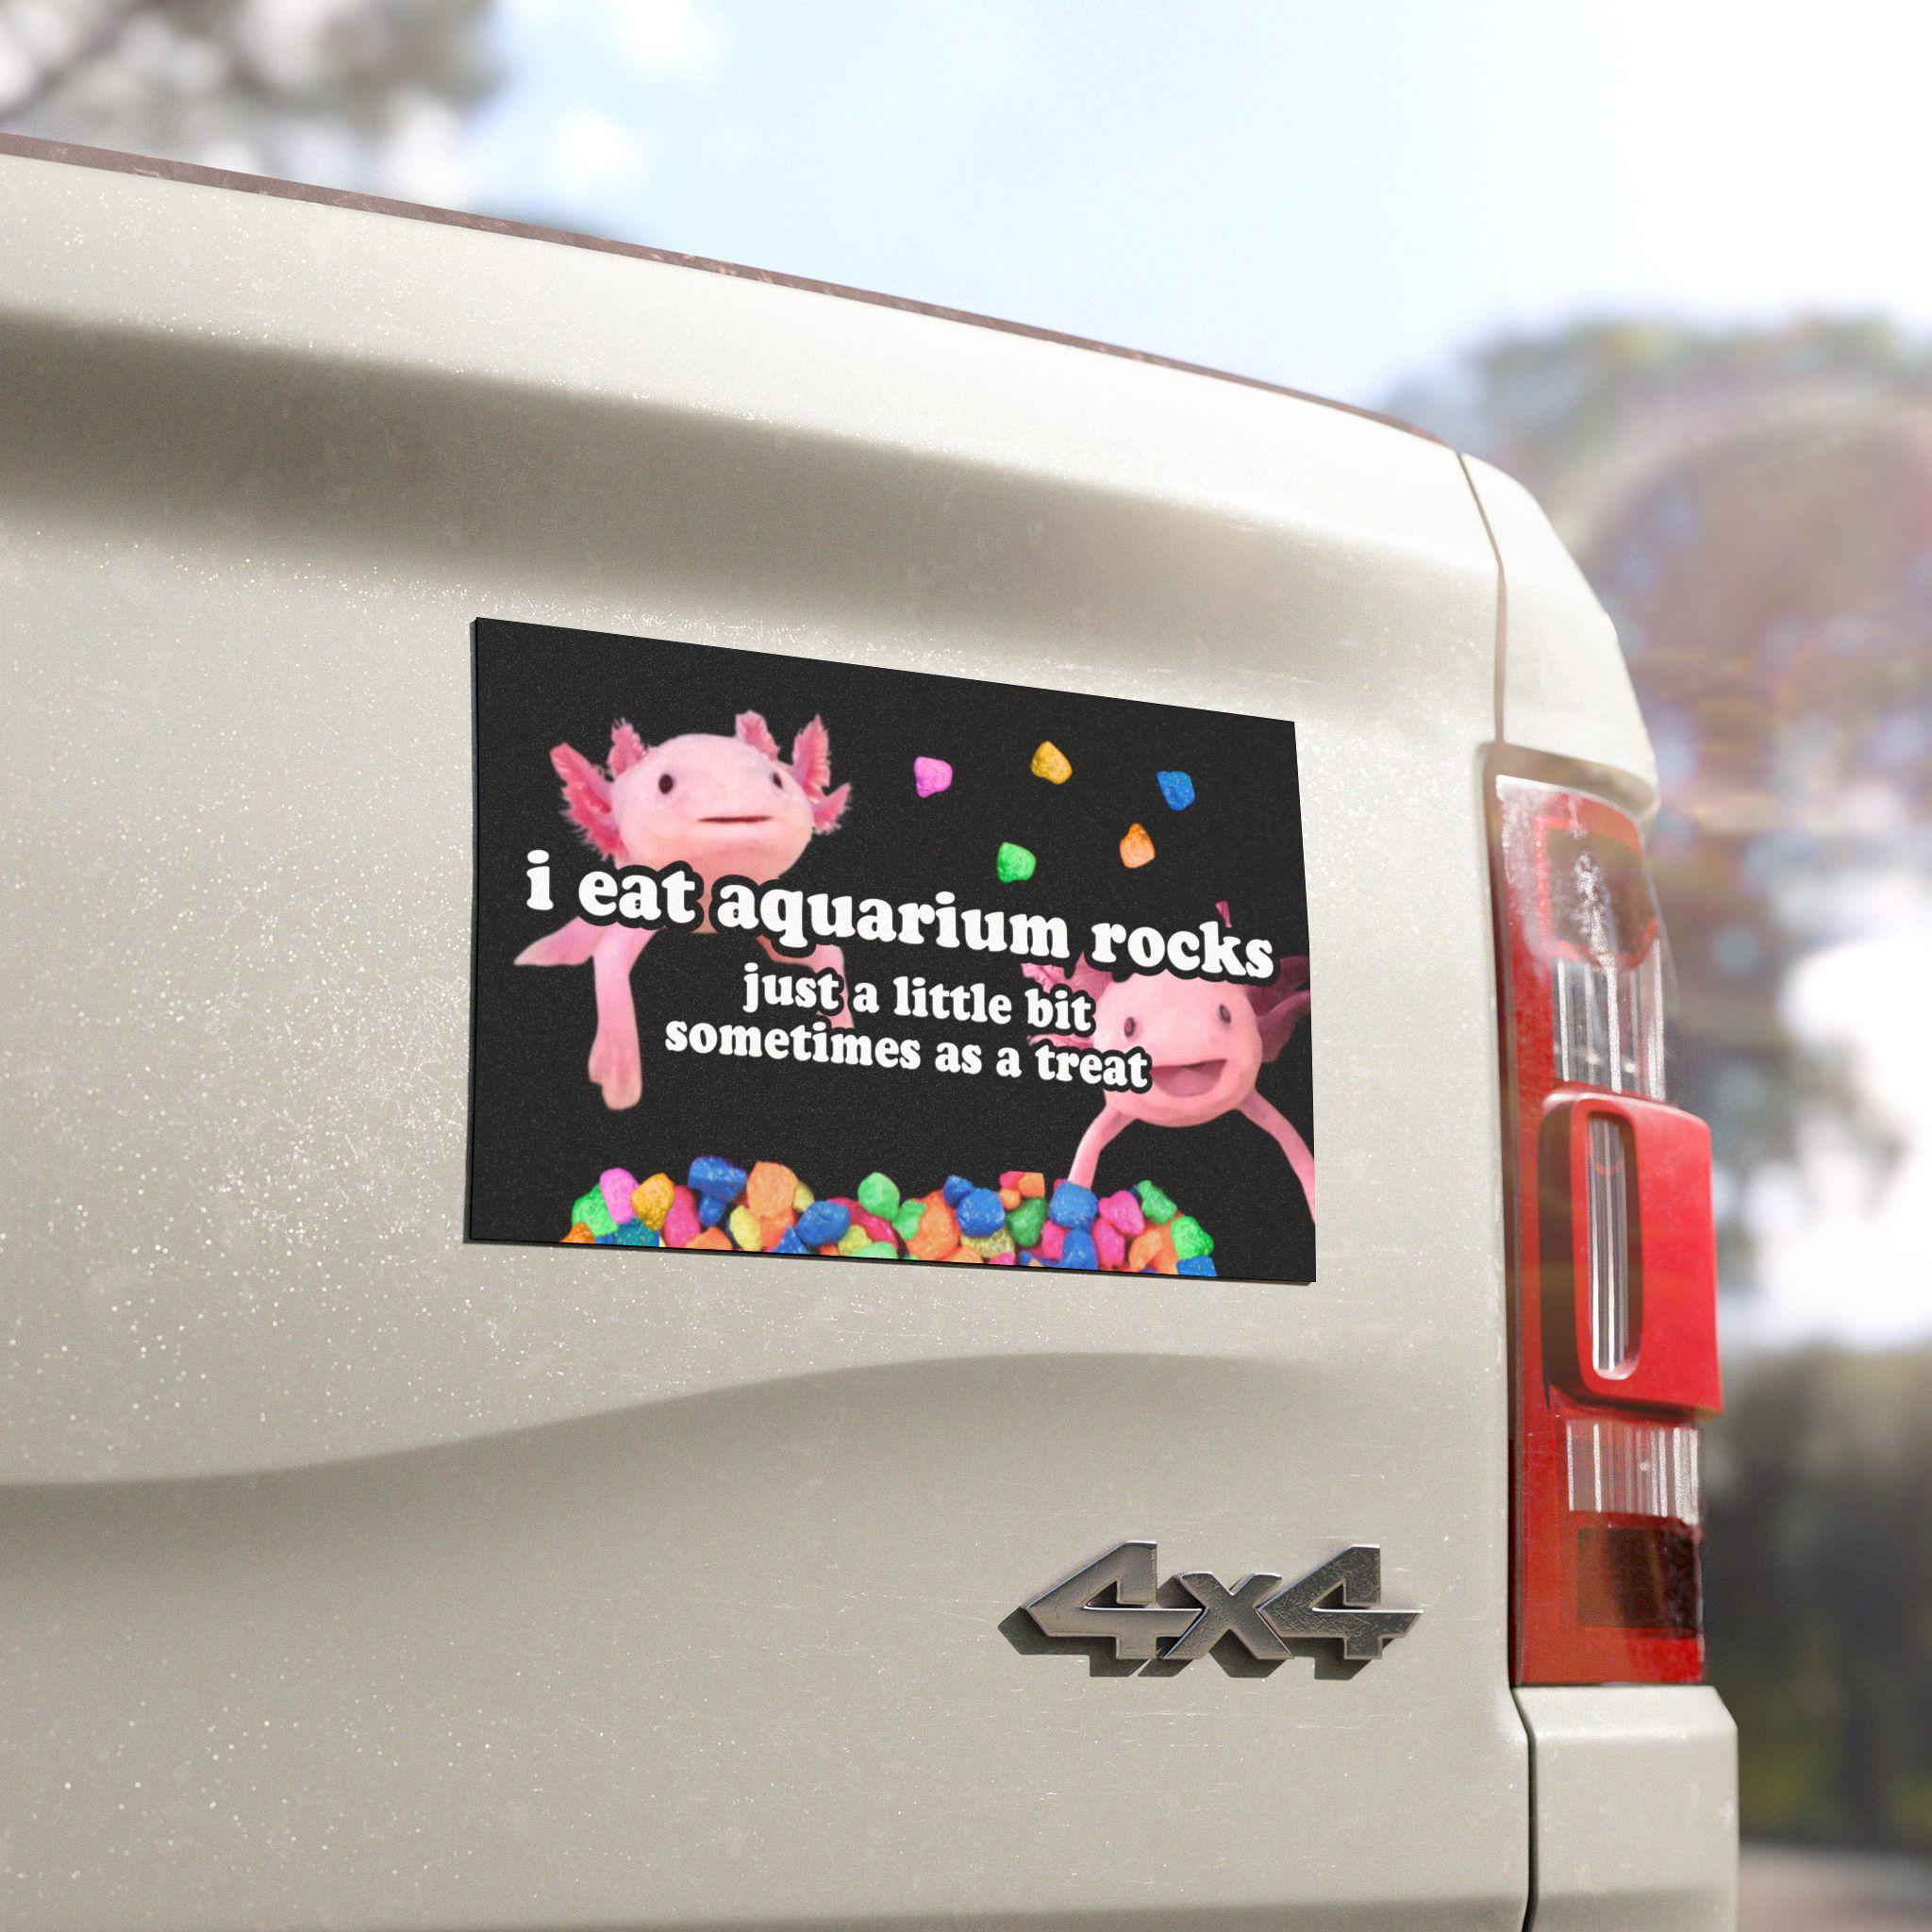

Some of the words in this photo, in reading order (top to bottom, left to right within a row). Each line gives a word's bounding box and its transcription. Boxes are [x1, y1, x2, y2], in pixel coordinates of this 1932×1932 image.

[525, 849, 555, 911] i
[577, 870, 696, 924] eat
[717, 884, 1072, 959] aquarium
[1090, 921, 1275, 979] rocks
[742, 962, 840, 1014] just
[853, 982, 881, 1014] a
[891, 975, 1013, 1026] little
[1024, 988, 1093, 1033] bit
[664, 1020, 921, 1071] sometimes
[935, 1041, 983, 1075] as
[995, 1047, 1024, 1079] a
[1035, 1044, 1150, 1089] treat
[1024, 1540, 1425, 1660] 4x4
